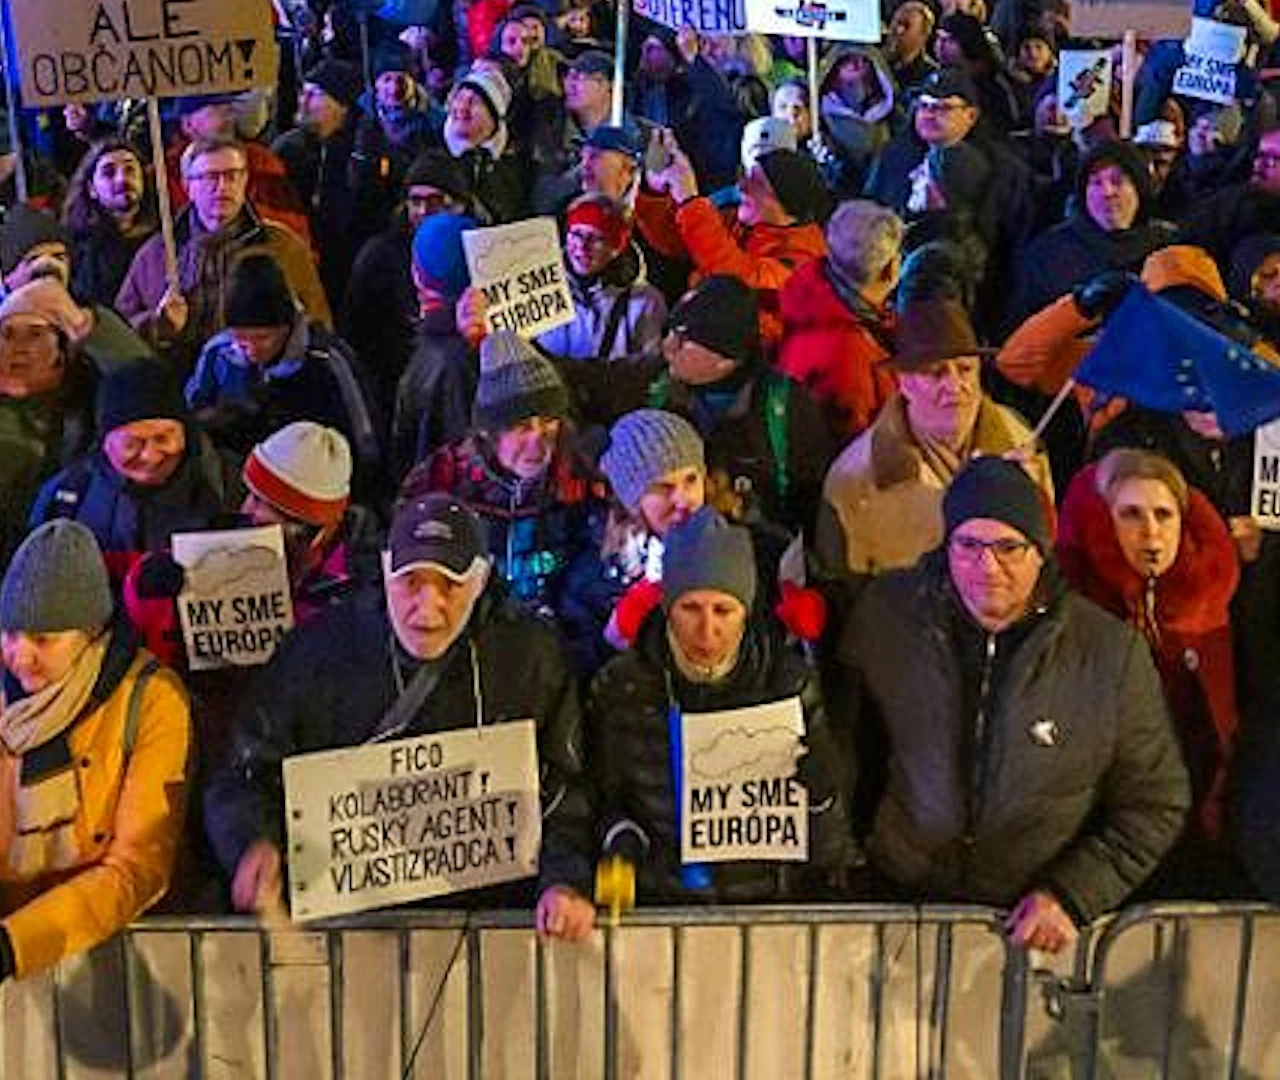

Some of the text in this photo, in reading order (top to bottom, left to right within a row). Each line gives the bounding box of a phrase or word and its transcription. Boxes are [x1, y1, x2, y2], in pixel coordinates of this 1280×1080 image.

[33, 37, 256, 98] OBČANOM!
[482, 262, 561, 305] MY SME
[187, 590, 286, 627] MY SME
[391, 744, 444, 773] FICO
[691, 777, 799, 813] MY SME
[691, 809, 799, 848] EURÓPA
